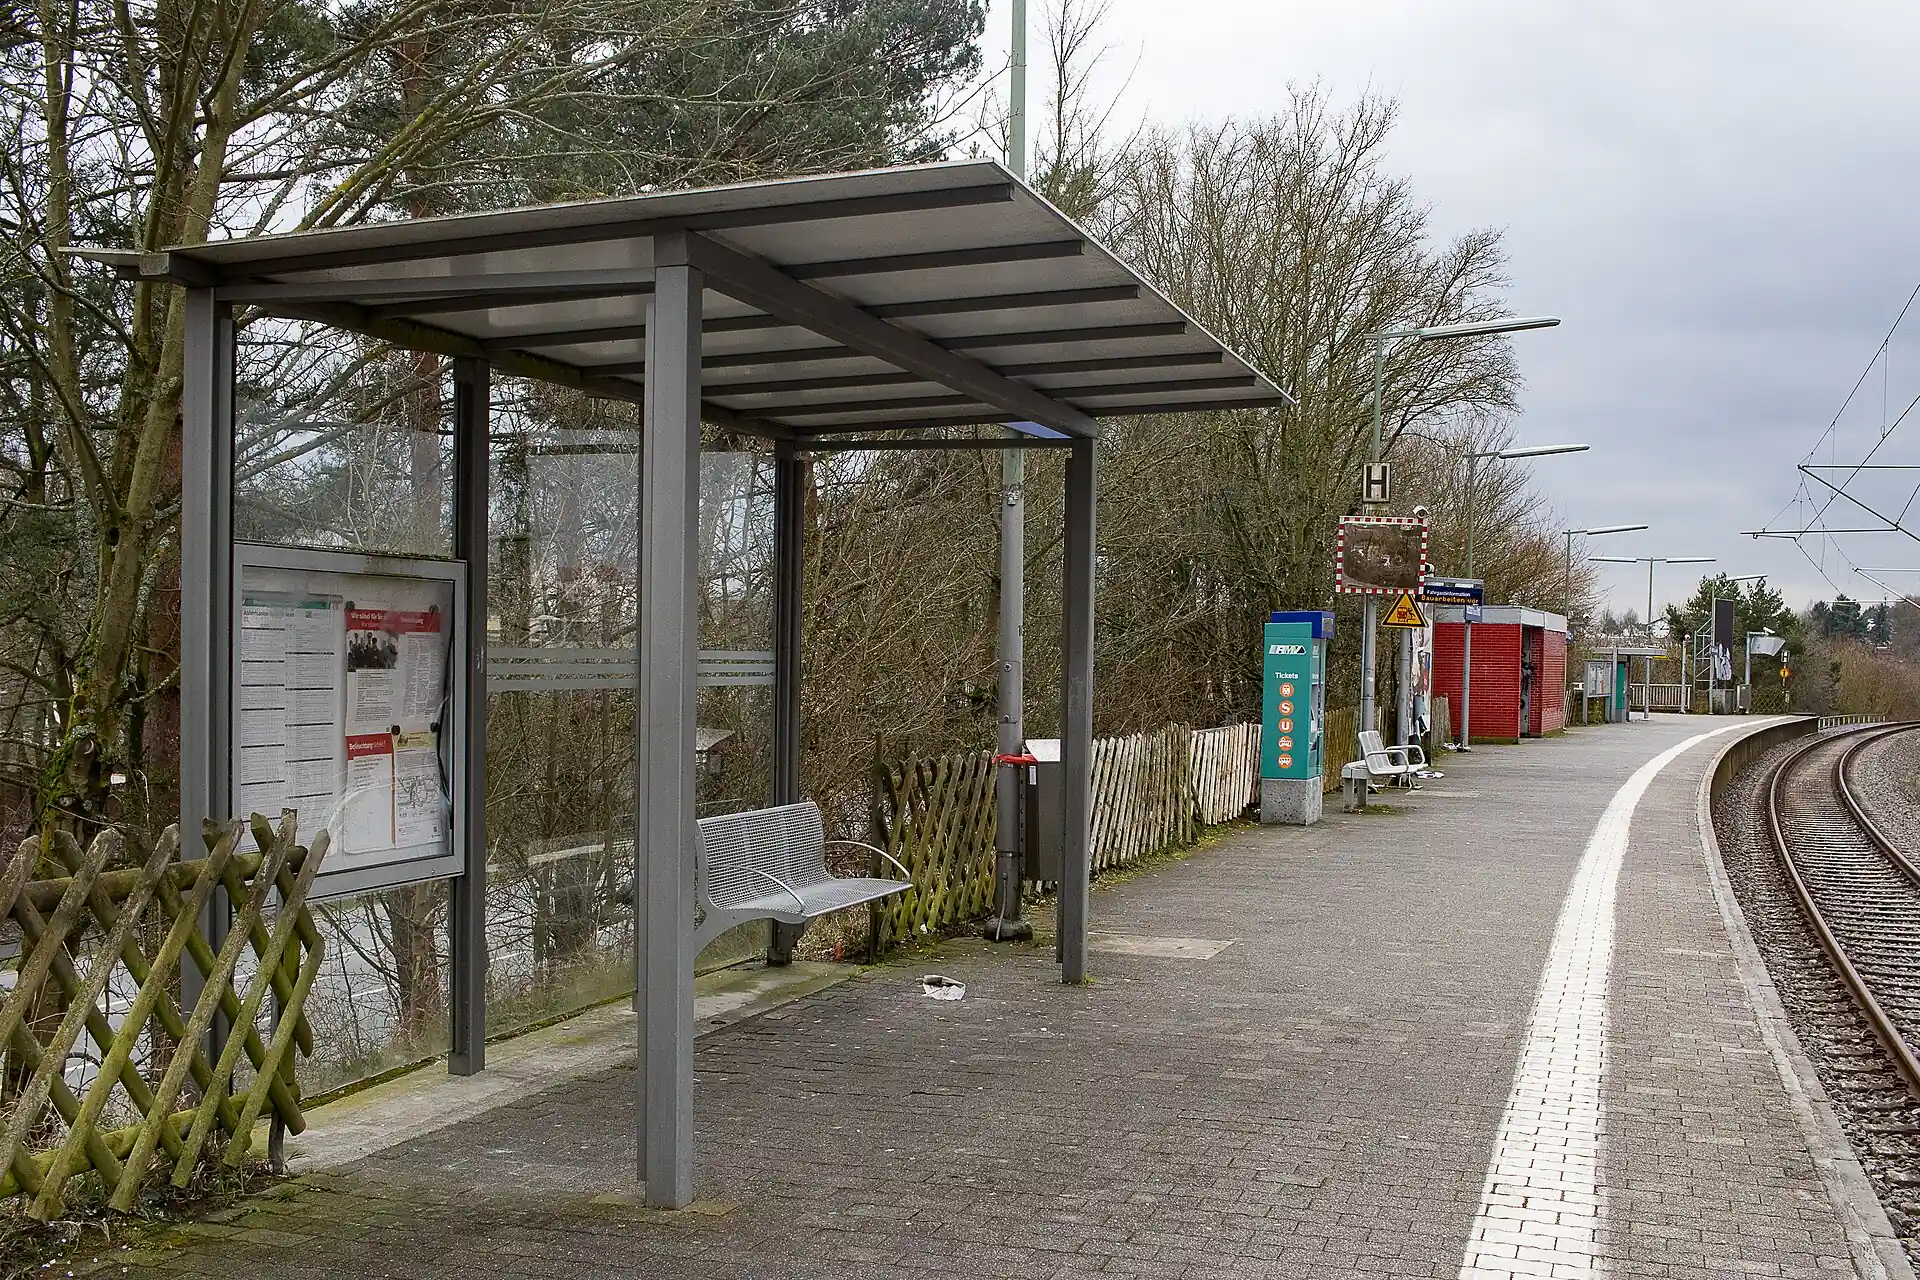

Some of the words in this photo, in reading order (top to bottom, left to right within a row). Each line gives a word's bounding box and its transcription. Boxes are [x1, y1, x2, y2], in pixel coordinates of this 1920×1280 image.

[1366, 465, 1387, 499] H
[1426, 589, 1471, 597] Fahrgastinformation
[1421, 594, 1466, 604] Bauarbeiten
[1281, 702, 1291, 714] S
[1281, 720, 1290, 731] U
